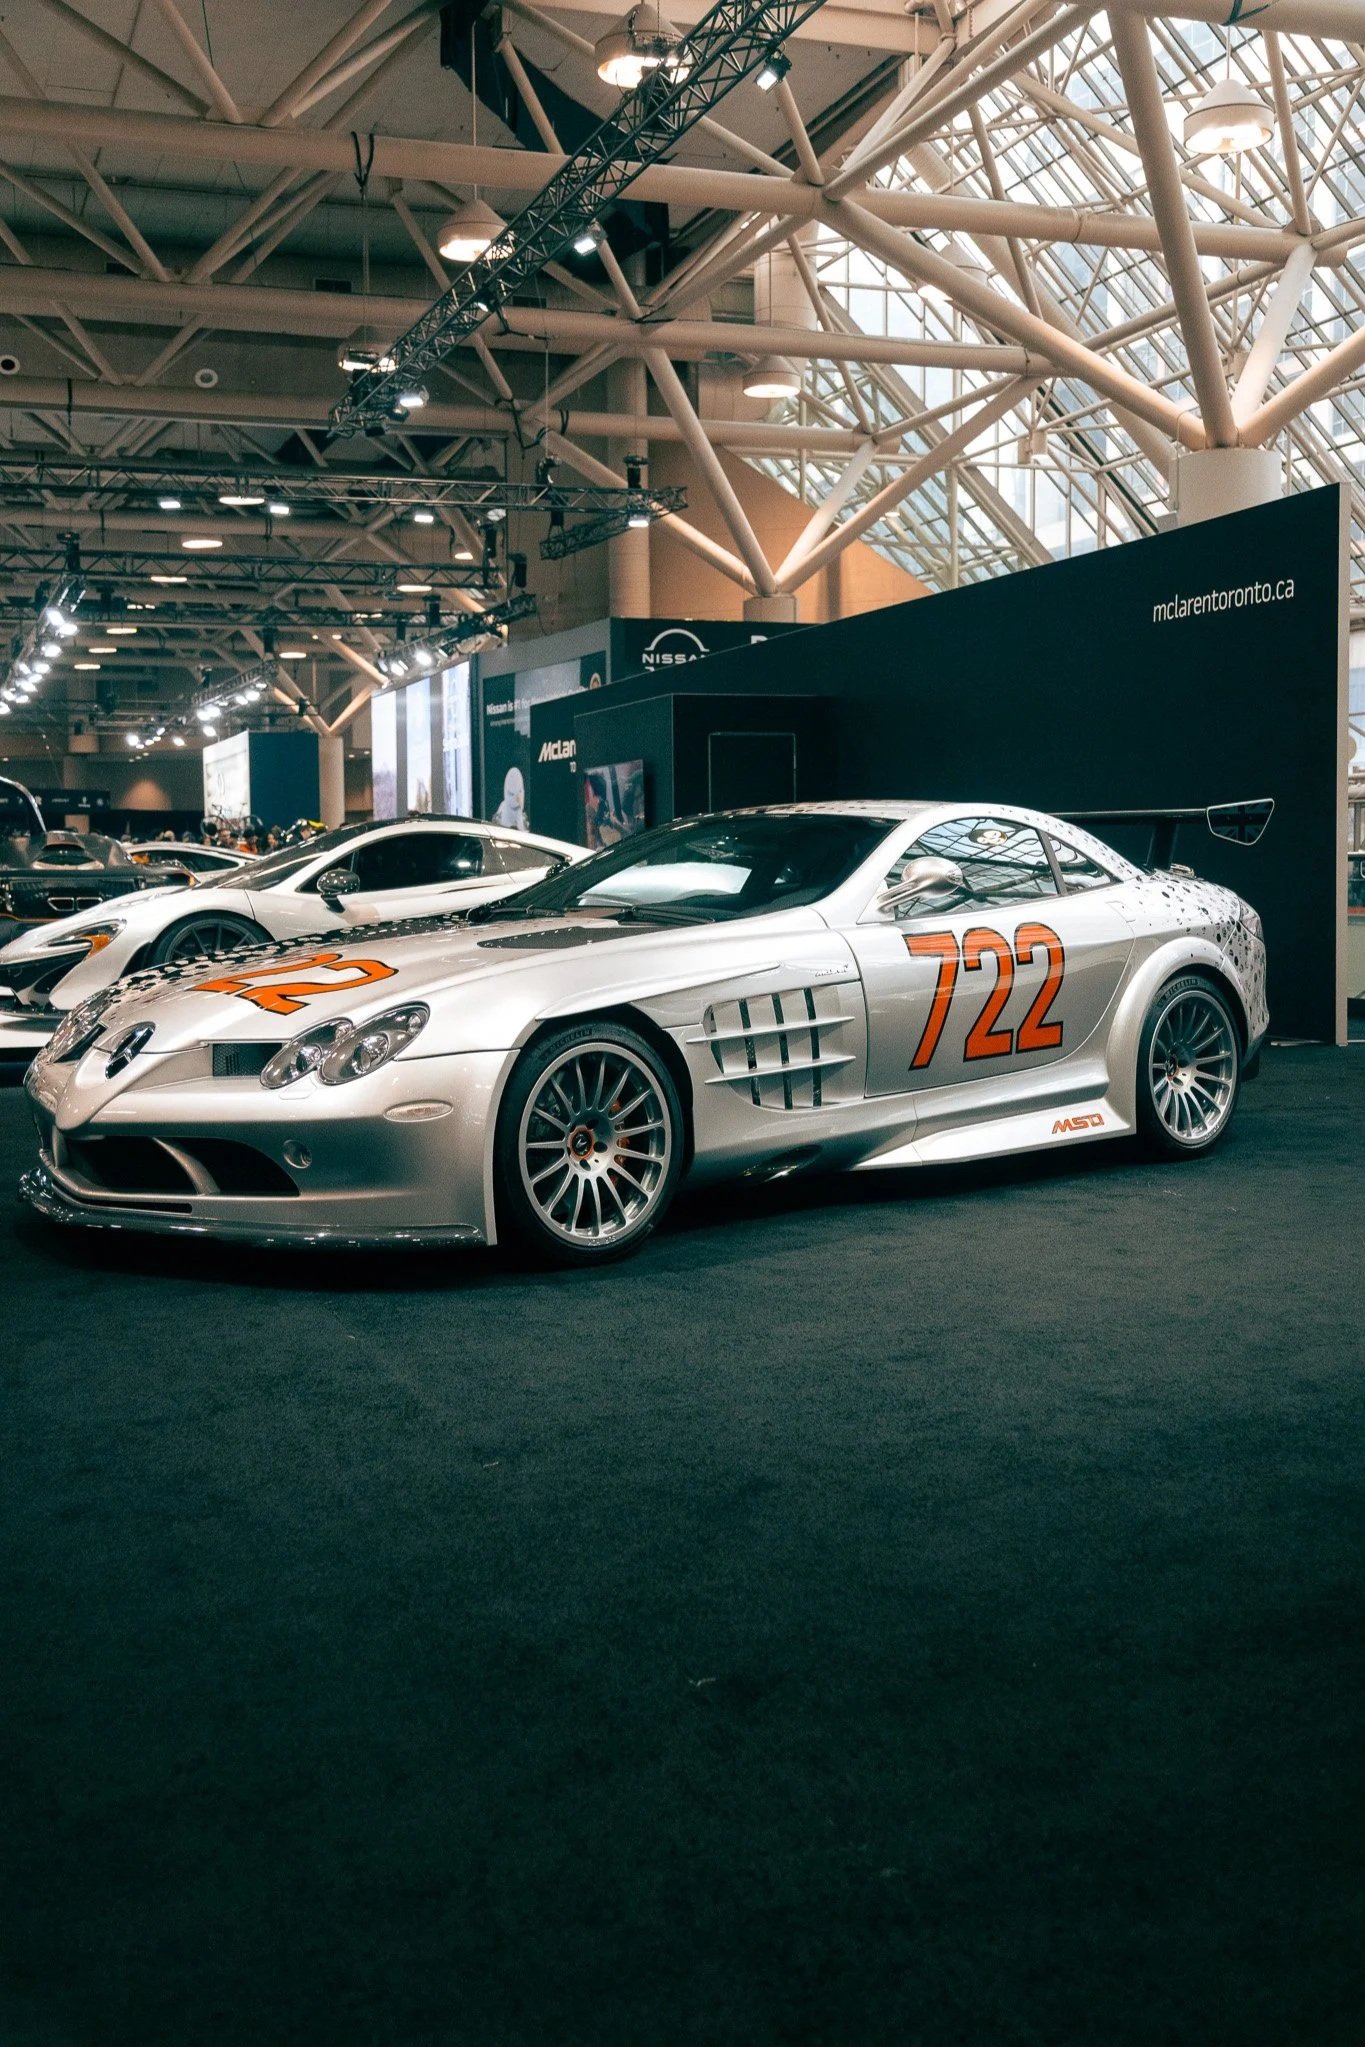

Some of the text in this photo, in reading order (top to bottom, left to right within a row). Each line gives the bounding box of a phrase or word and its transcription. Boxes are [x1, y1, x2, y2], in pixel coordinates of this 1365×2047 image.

[1153, 578, 1295, 622] mclarentoronto.ca
[642, 653, 706, 664] NISSA
[486, 702, 507, 715] Nissan
[902, 922, 1065, 1071] 722
[1052, 1113, 1104, 1134] MSD
